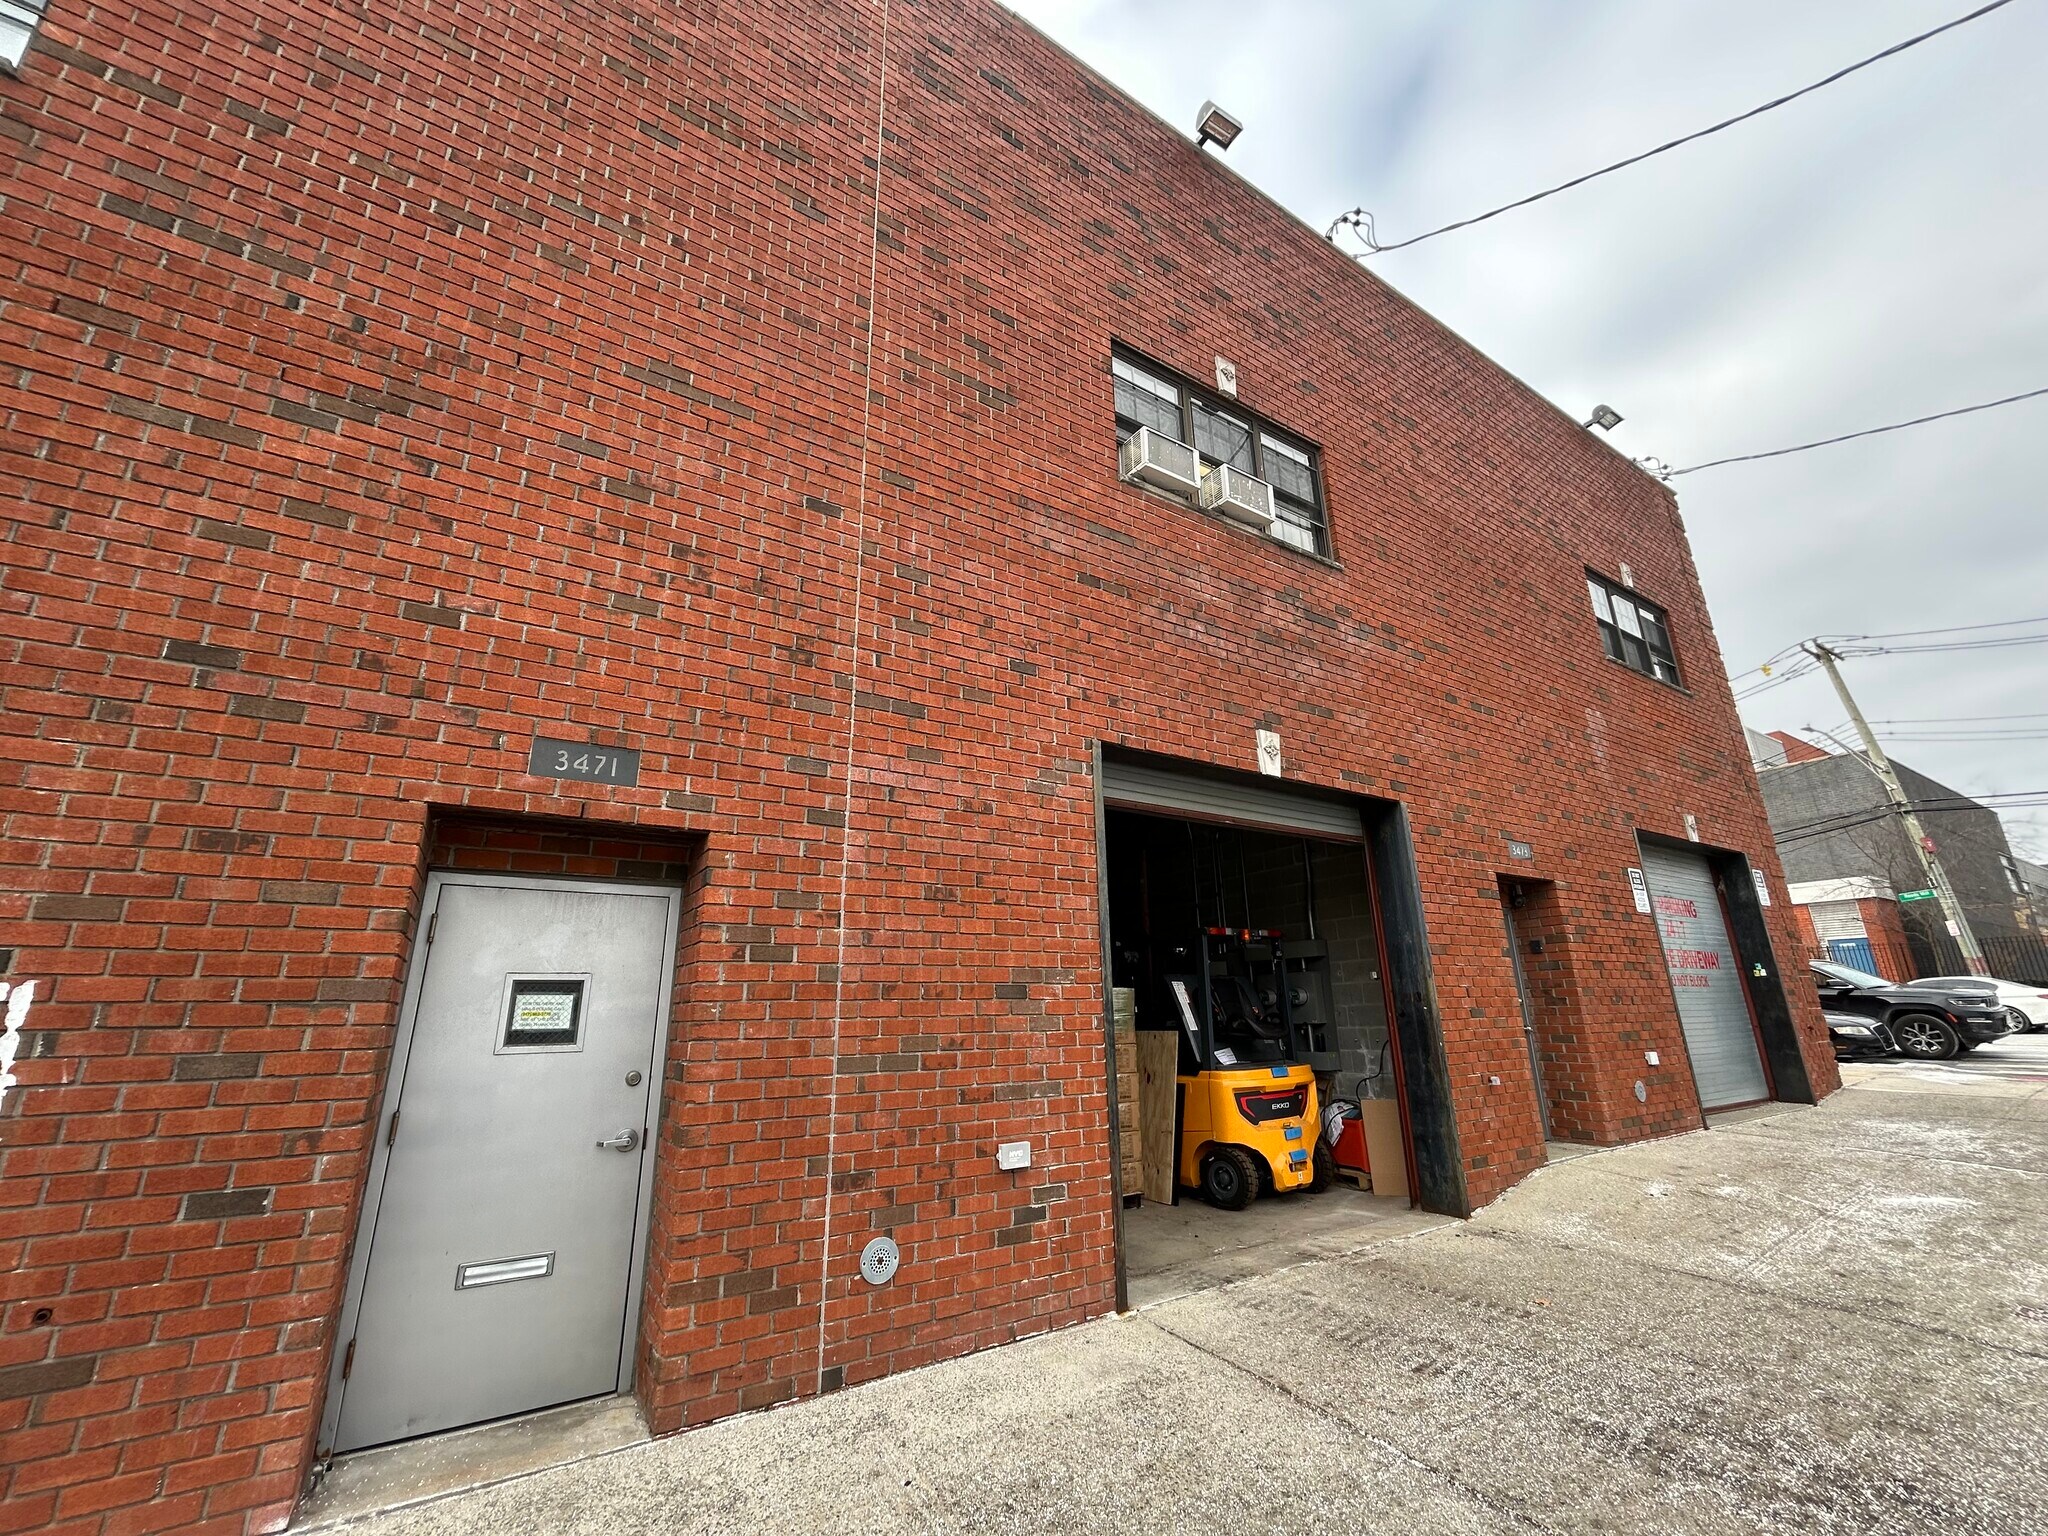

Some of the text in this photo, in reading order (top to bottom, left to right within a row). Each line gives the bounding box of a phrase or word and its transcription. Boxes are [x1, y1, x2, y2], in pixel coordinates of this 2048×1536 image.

[554, 750, 617, 777] 3471
[1678, 950, 1721, 970] DRIVEWAY
[1689, 976, 1710, 988] BLOCK
[1271, 1102, 1290, 1110] EKKO
